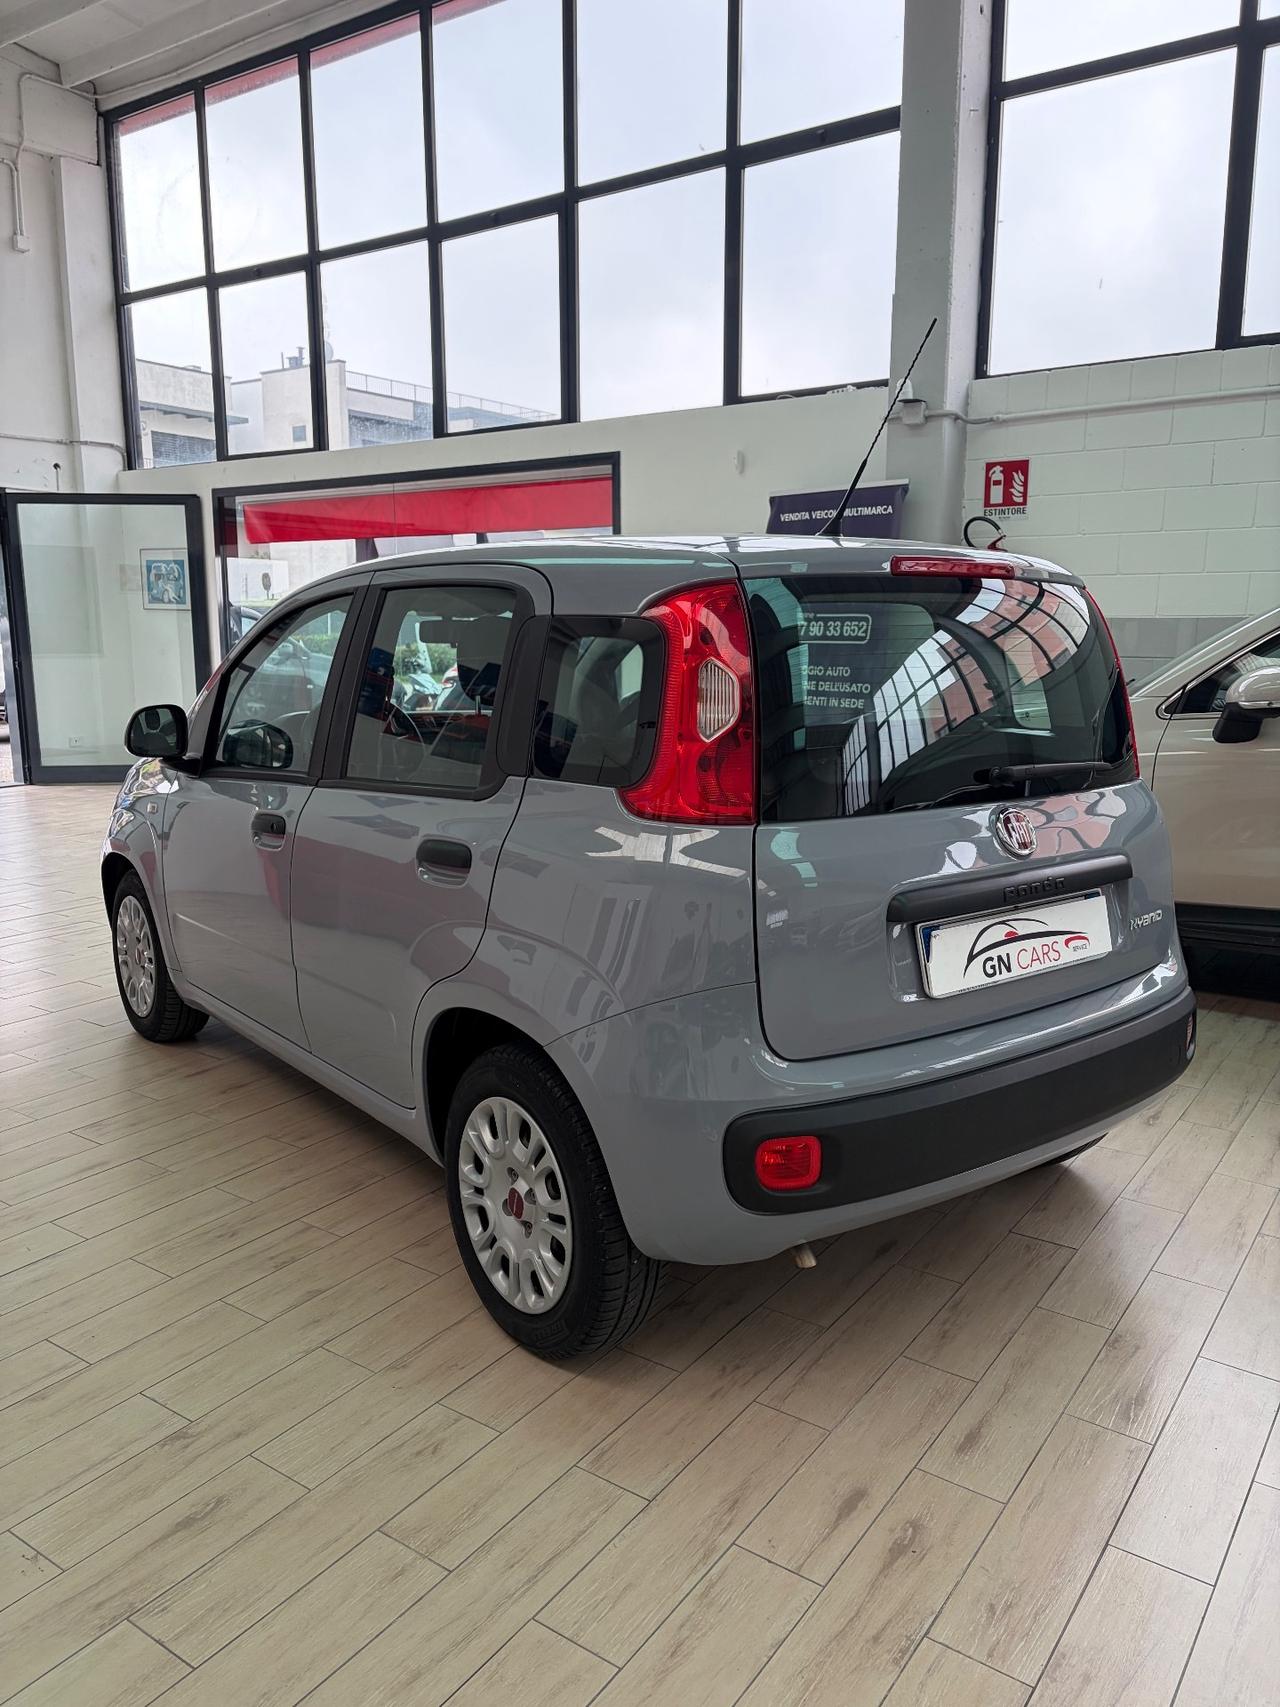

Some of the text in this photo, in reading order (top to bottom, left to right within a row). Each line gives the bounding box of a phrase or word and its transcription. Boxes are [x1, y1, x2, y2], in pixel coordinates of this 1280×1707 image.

[780, 505, 893, 522] VENDITA VEICO MULTIMARCA
[983, 506, 1027, 516] ESTINTORE
[808, 621, 824, 637] 90
[826, 621, 841, 637] 33
[843, 621, 867, 637] 652
[825, 666, 851, 677] AUTO
[818, 681, 871, 694] DELL'USATO
[828, 697, 838, 707] IN
[839, 698, 864, 709] SEDE
[1007, 818, 1032, 849] FIAT
[982, 940, 1061, 979] GN CARS
